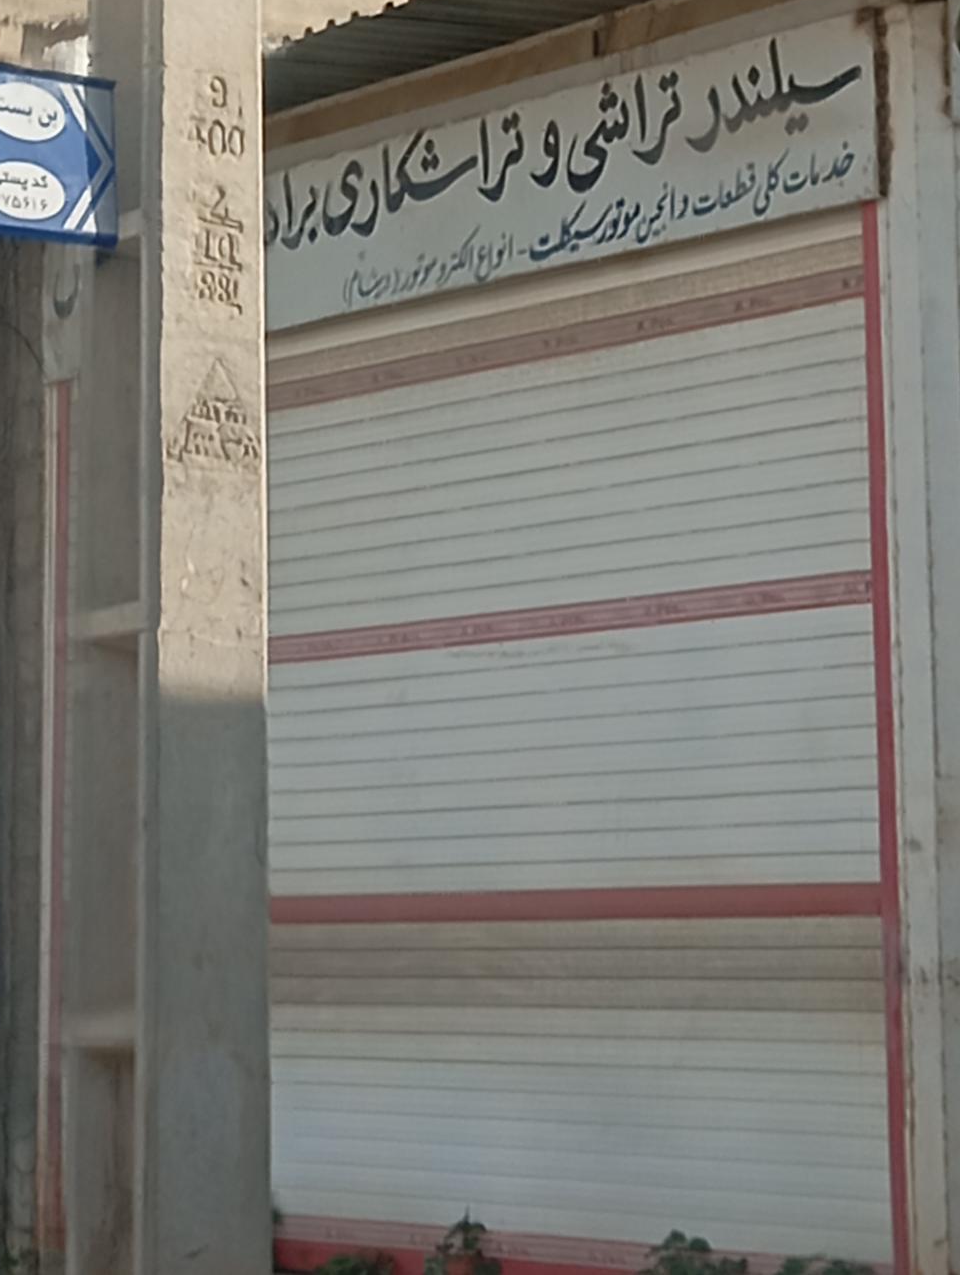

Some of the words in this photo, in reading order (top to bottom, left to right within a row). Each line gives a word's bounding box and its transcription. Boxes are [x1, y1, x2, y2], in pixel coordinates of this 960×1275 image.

[37, 108, 58, 129] بن
[685, 37, 862, 153] سیلندر
[530, 119, 561, 188] و
[567, 70, 682, 193] تراشی
[322, 111, 524, 238] تراشکاری
[693, 162, 755, 216] قطعات
[754, 149, 789, 216] کلی
[783, 141, 855, 194] خدمات
